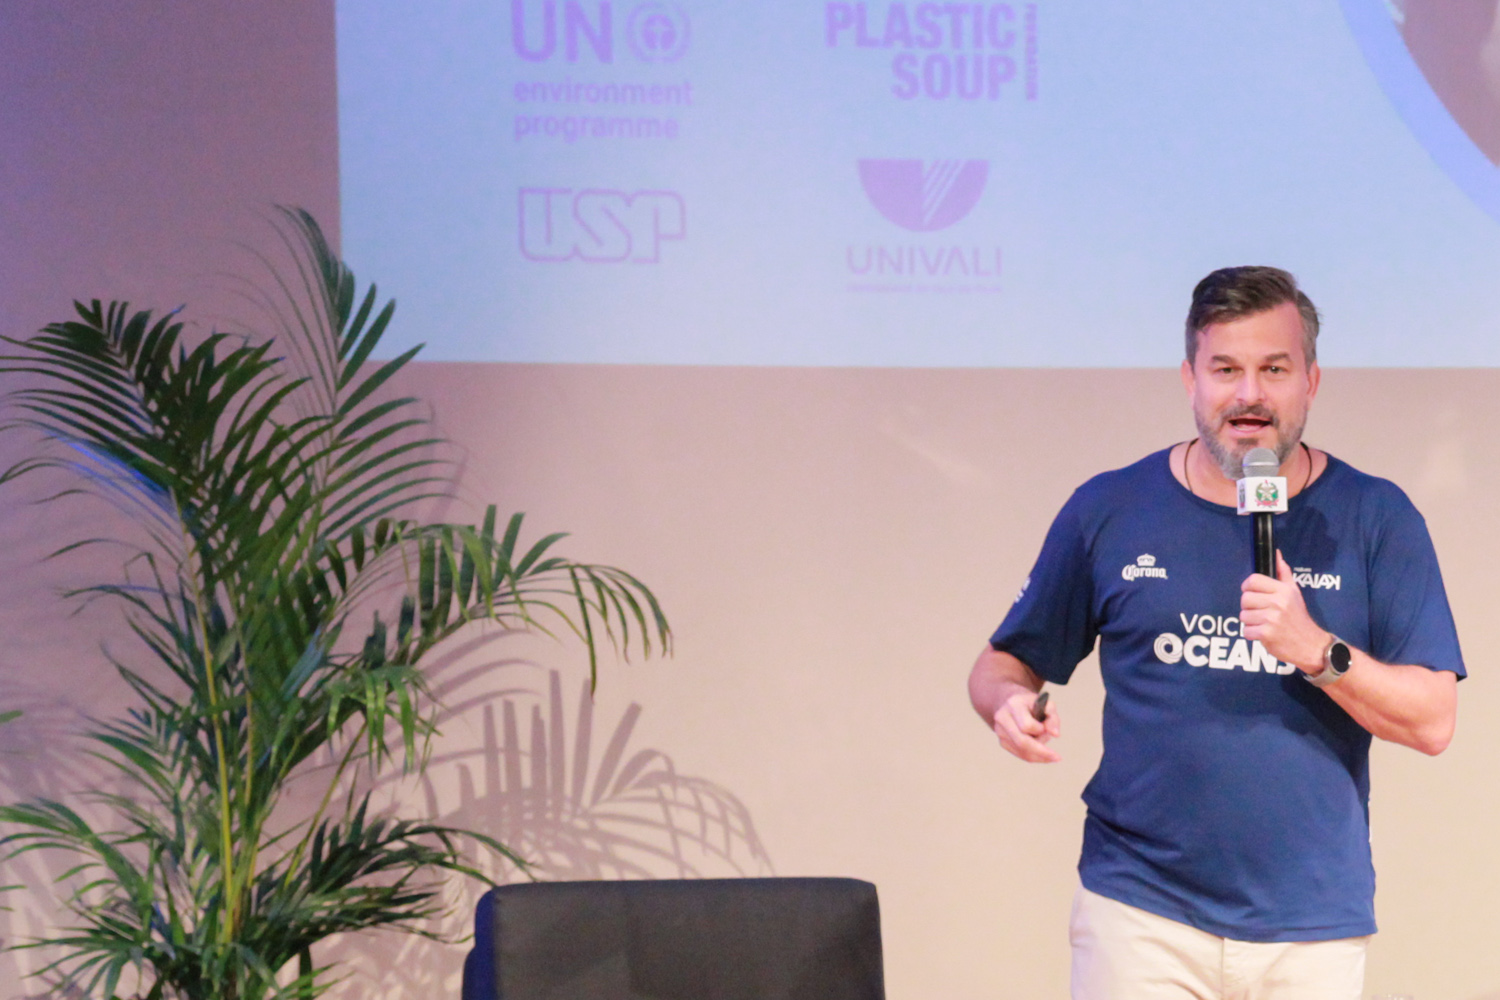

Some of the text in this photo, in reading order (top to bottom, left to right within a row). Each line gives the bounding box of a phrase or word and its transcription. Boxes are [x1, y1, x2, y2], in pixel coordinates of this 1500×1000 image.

[511, 0, 613, 63] UN
[825, 2, 1016, 49] PLASTIC
[514, 76, 693, 105] environment
[892, 53, 1017, 100] SOUP
[515, 115, 680, 143] programme
[846, 245, 1003, 276] UNIVALI
[1121, 564, 1166, 581] Corona
[1180, 613, 1246, 638] VOIC
